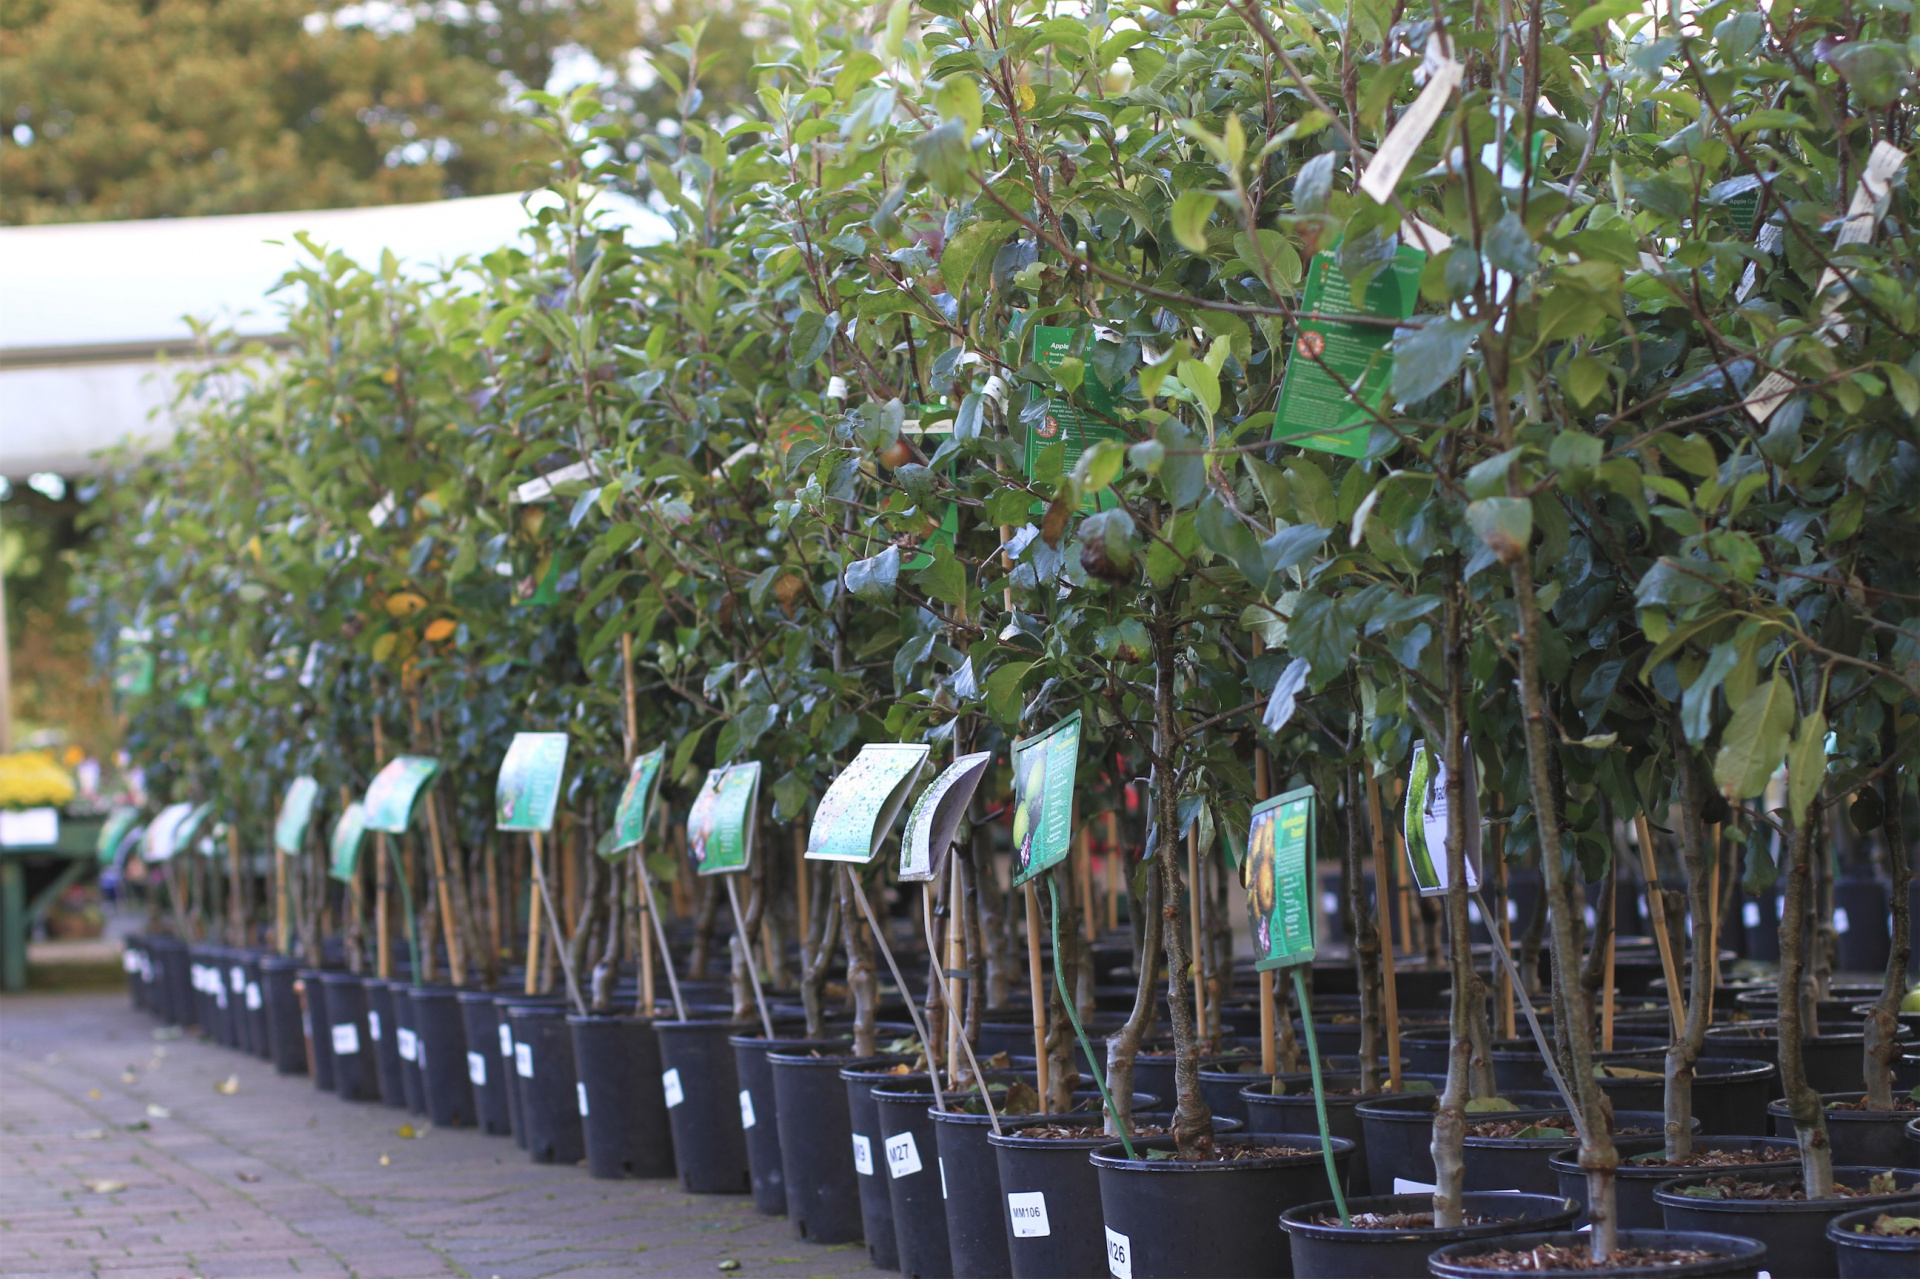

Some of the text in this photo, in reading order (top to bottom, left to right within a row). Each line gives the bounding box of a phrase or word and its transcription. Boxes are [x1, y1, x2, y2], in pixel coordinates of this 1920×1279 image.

[1050, 342, 1070, 351] Apple
[889, 1143, 908, 1164] M27
[1013, 1206, 1041, 1218] MM106
[1107, 1238, 1126, 1264] M26
